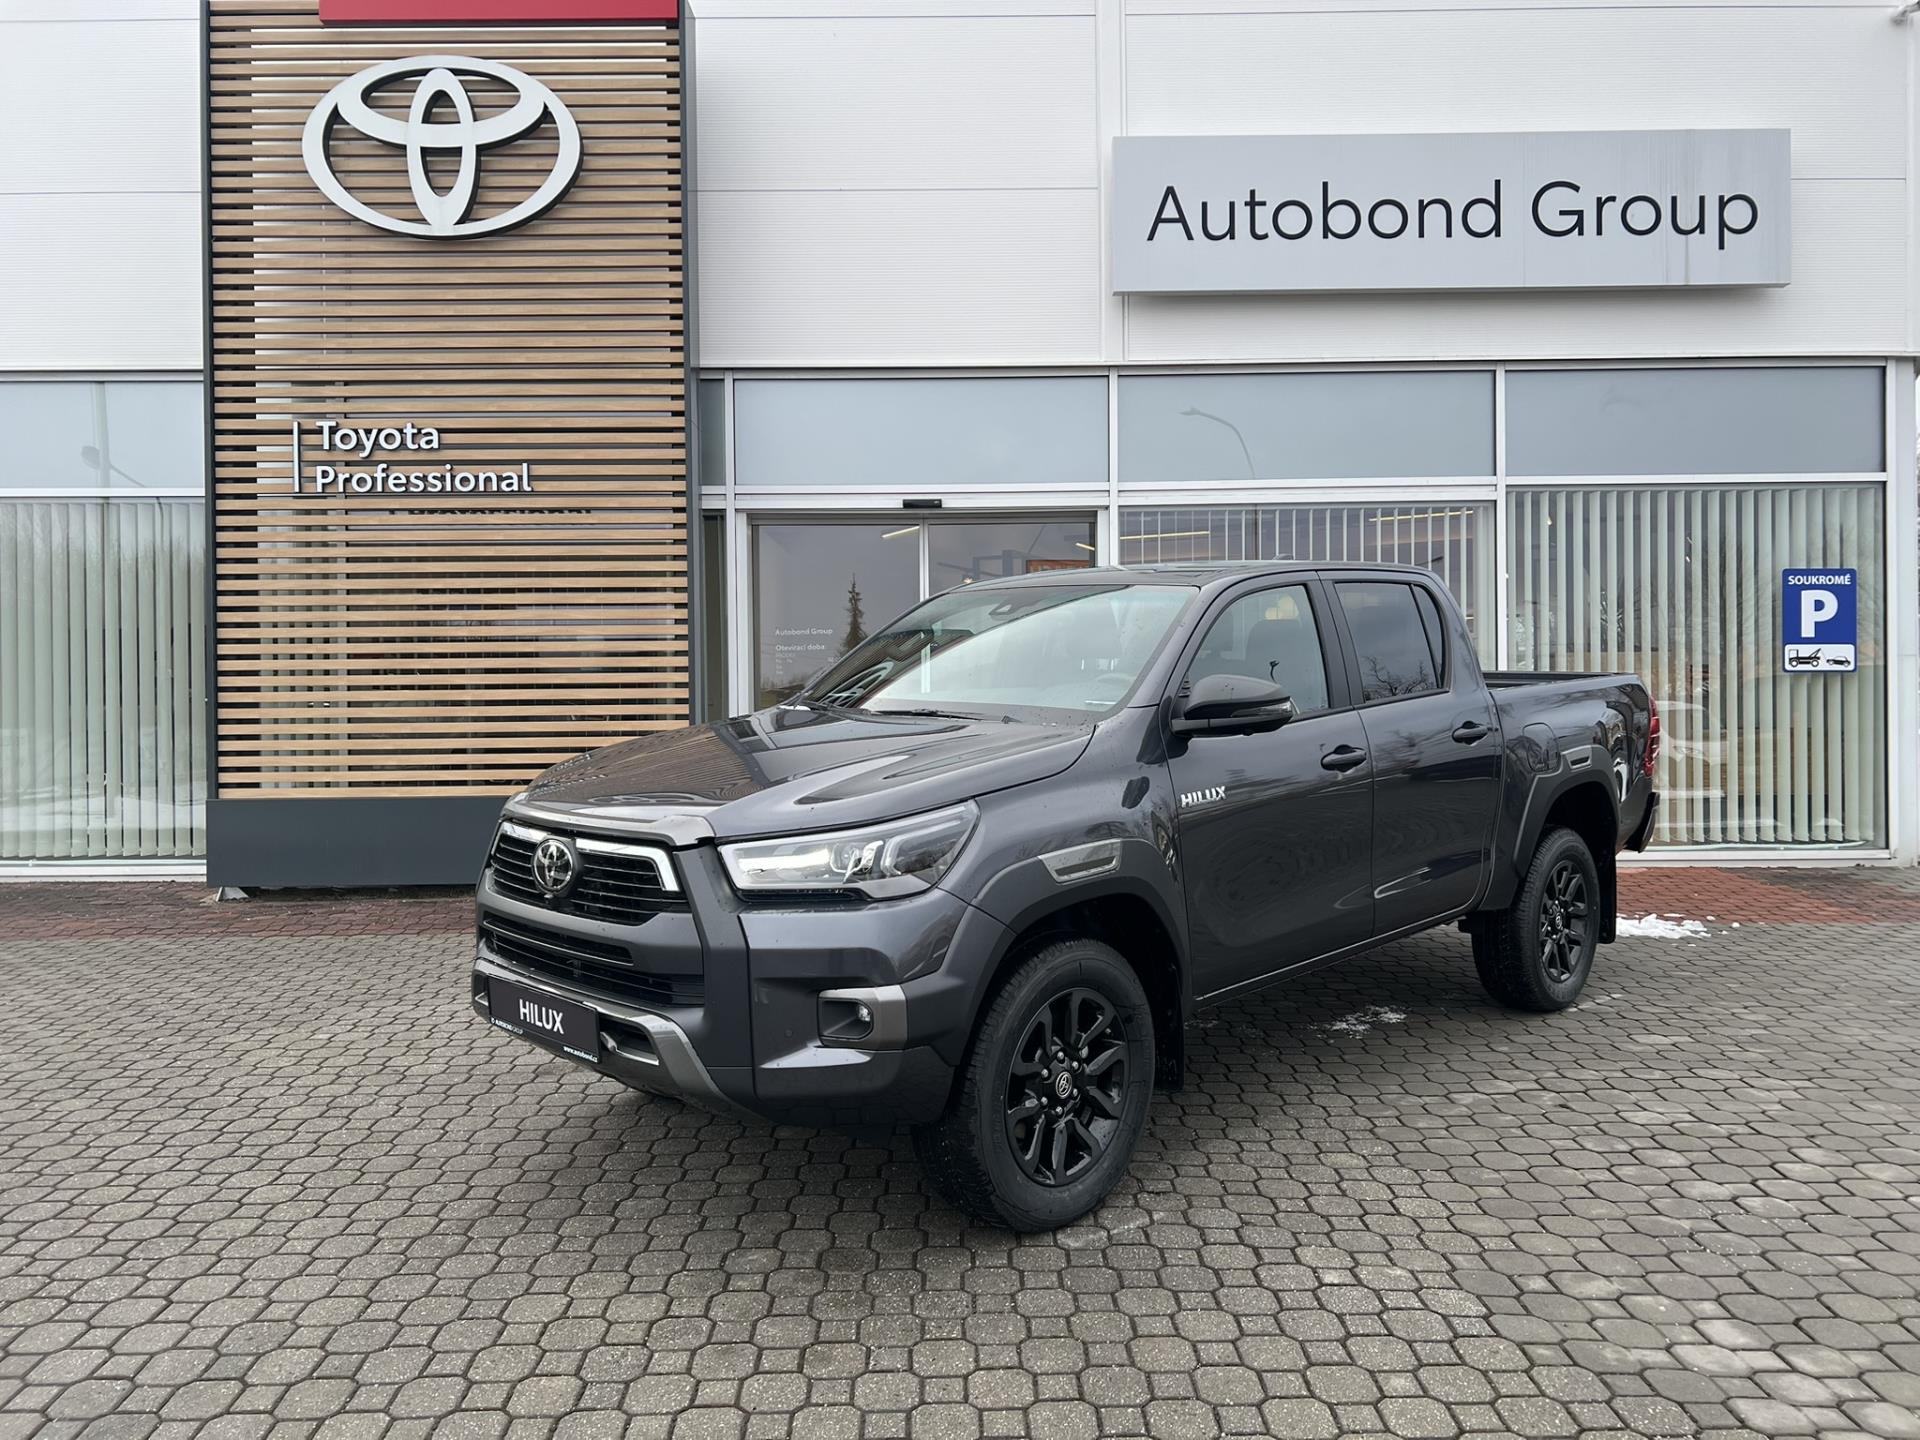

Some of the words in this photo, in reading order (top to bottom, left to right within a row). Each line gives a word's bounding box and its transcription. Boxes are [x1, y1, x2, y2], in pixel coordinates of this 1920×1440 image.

[1146, 180, 1501, 242] Autobond
[1531, 180, 1759, 250] Group
[315, 420, 440, 459] Toyota
[315, 462, 533, 494] Professional
[1787, 573, 1852, 585] SOUKROMÉ
[1800, 589, 1839, 638] P
[775, 627, 810, 637] Autobond
[810, 627, 833, 637] Group
[806, 643, 825, 651] doba
[1180, 785, 1227, 808] HILUX
[518, 998, 565, 1035] HILUX
